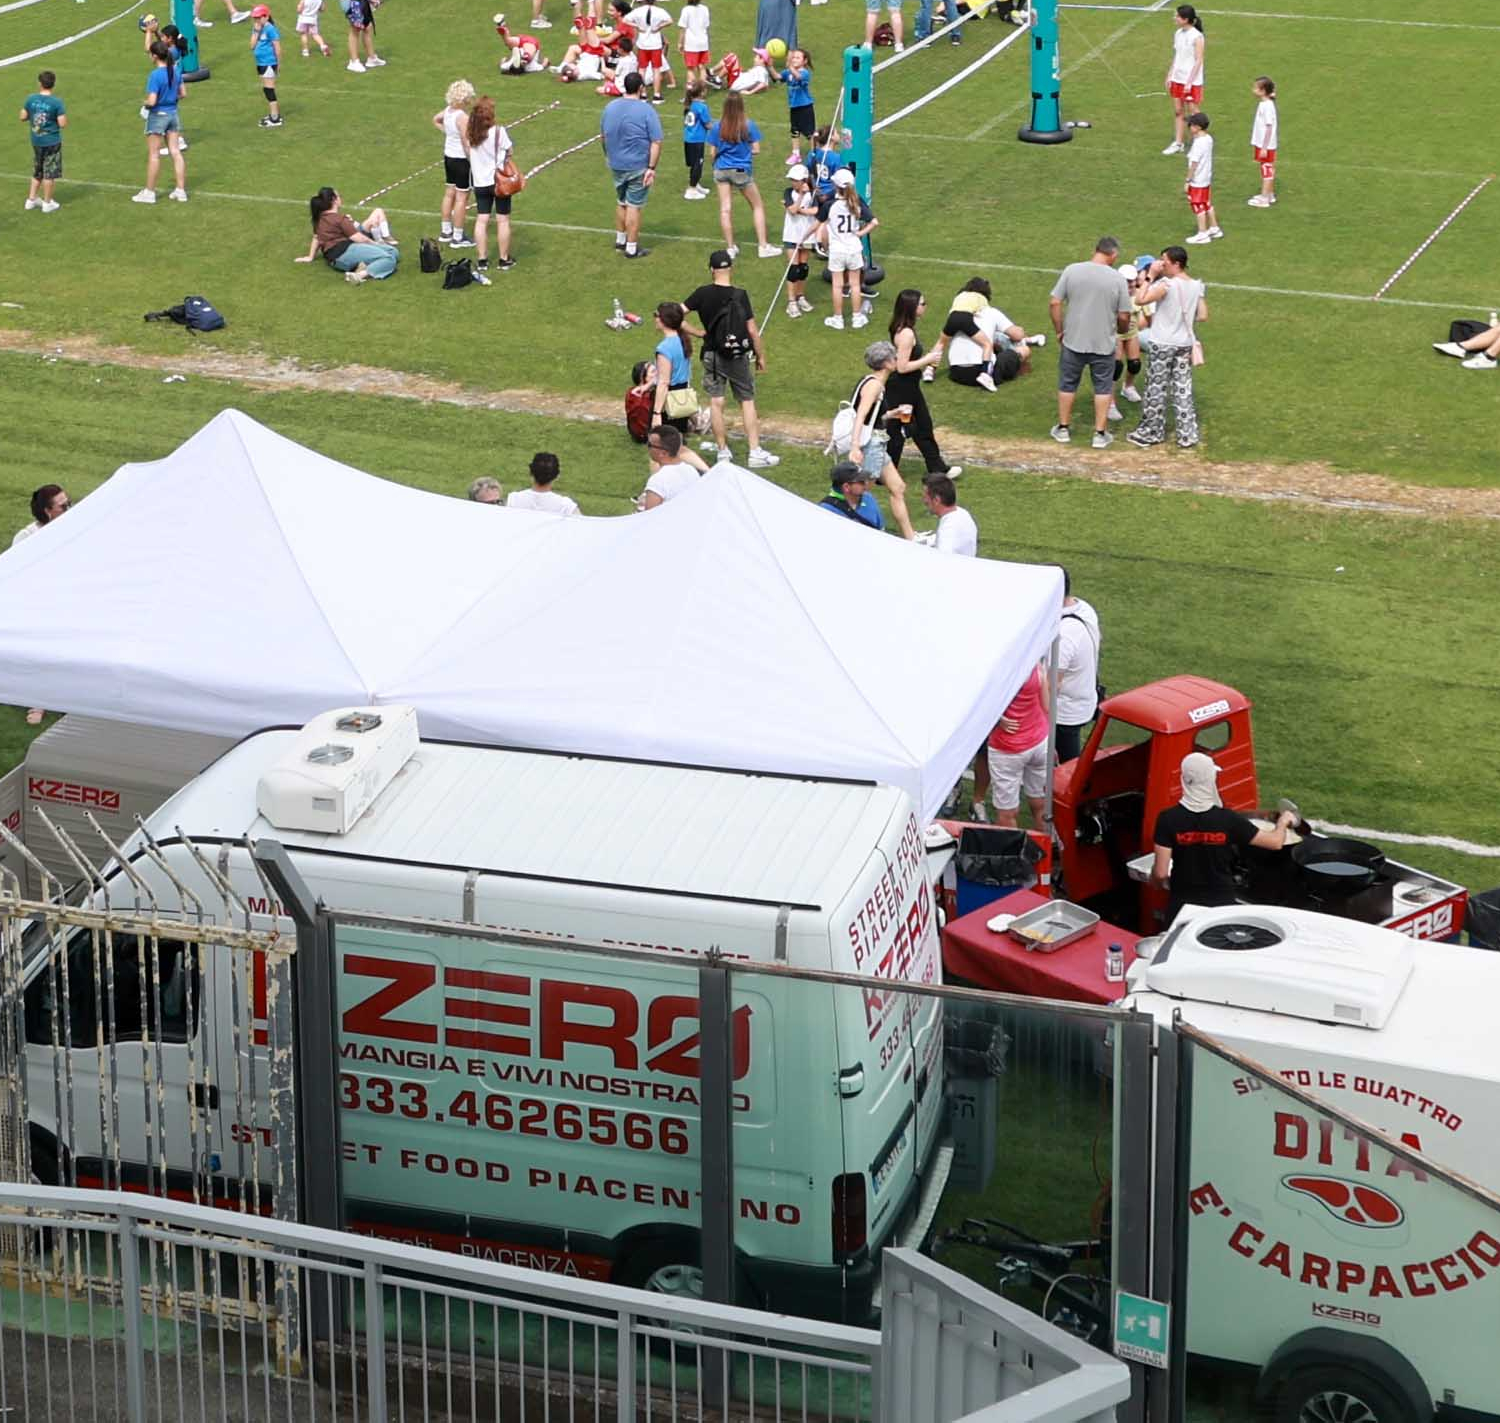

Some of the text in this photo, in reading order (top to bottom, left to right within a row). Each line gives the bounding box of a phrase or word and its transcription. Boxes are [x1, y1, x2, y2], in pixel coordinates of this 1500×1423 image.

[837, 214, 852, 234] 21
[337, 1042, 751, 1112] MANGIA E VIVI NOSTRAO
[1232, 1070, 1463, 1132] SOTO LE QUATTRO
[336, 1072, 690, 1156] 333.4626566
[402, 1149, 511, 1183] FOOD
